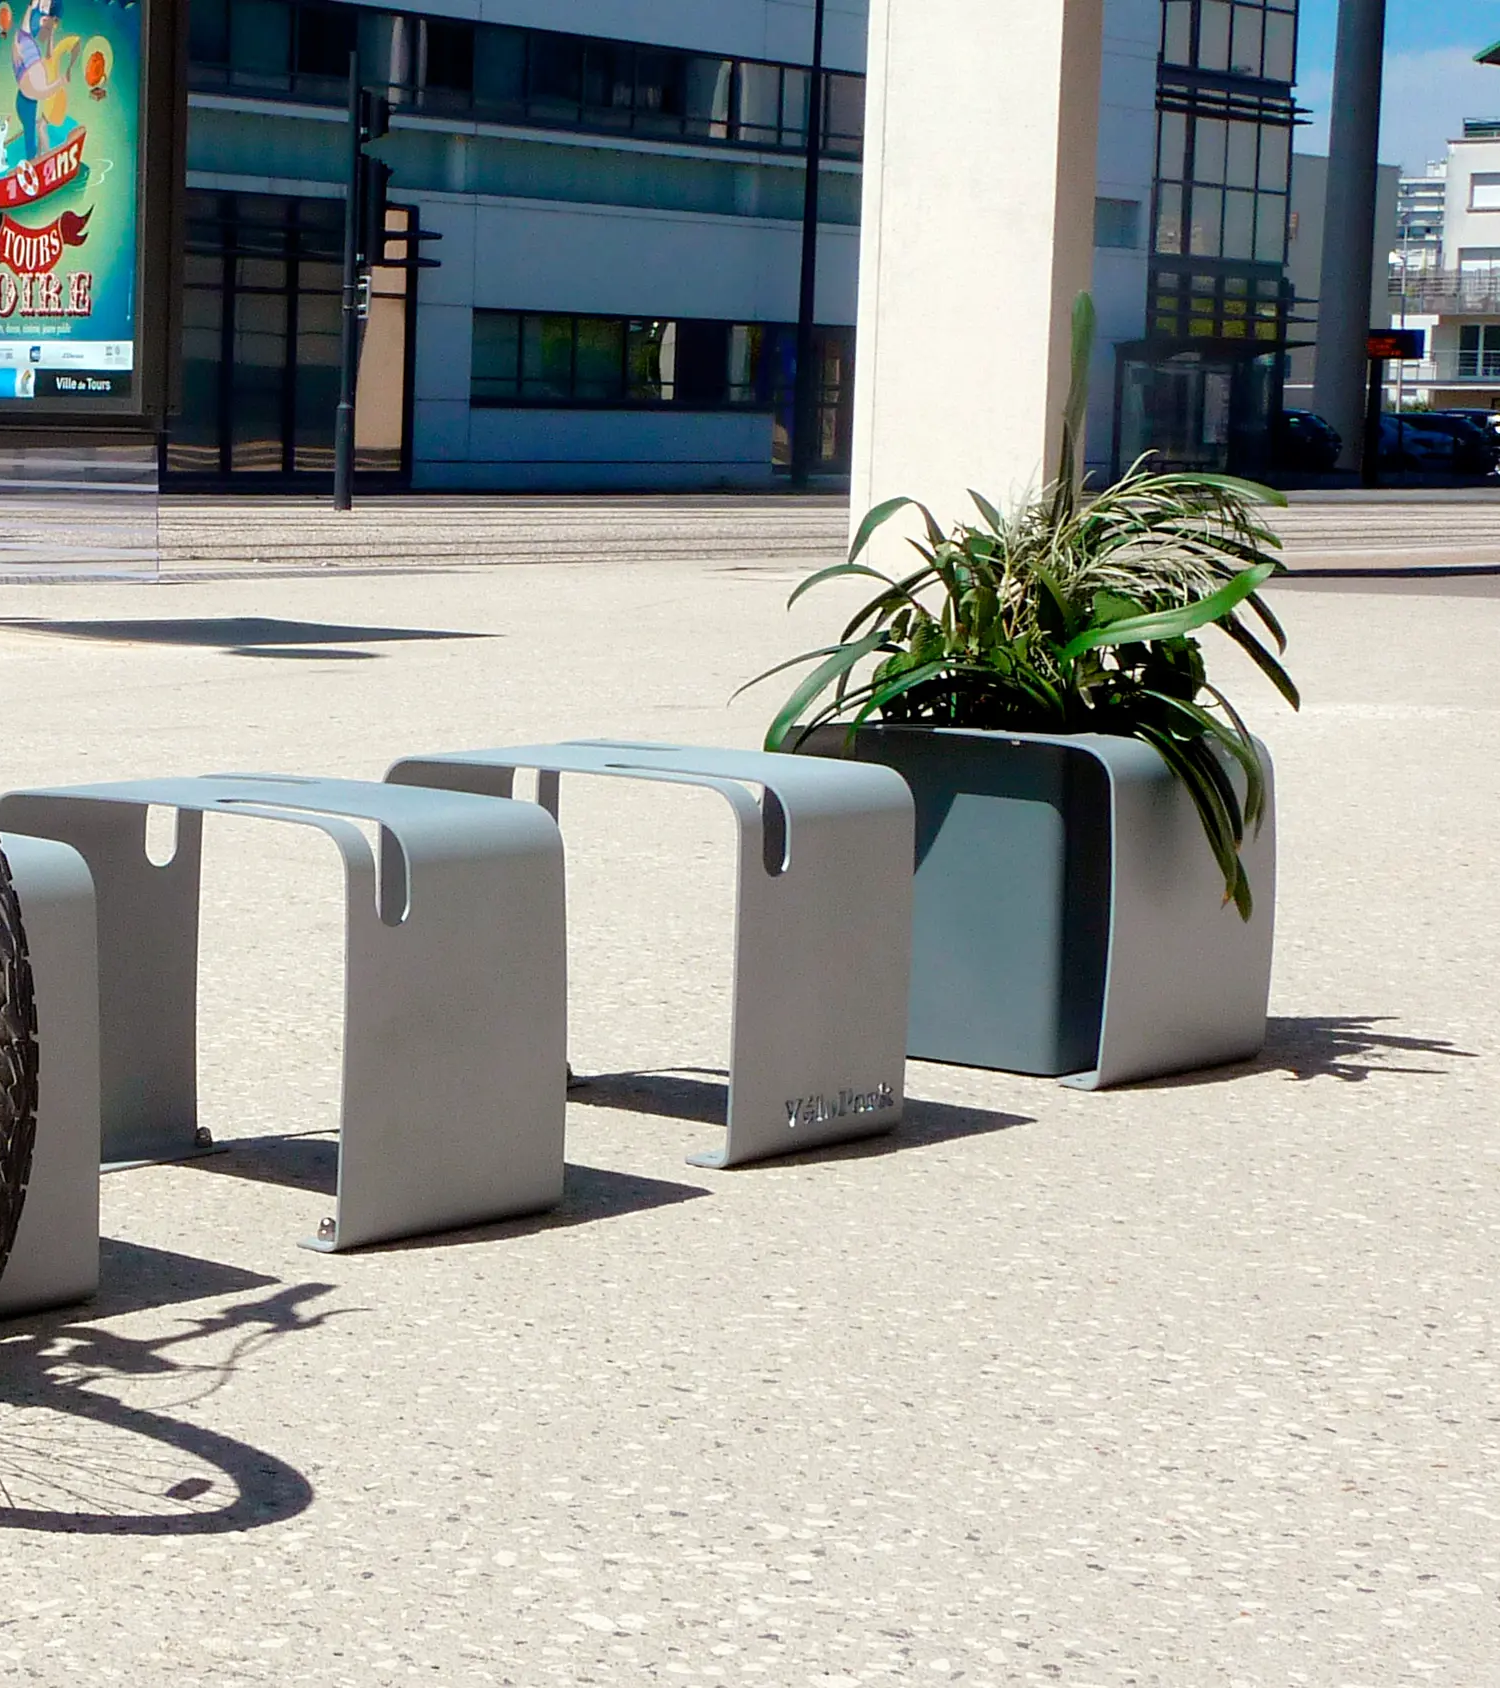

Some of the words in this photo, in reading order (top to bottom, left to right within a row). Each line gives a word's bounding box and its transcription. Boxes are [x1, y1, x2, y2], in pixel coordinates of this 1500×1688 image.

[3, 226, 61, 271] TOURS
[55, 376, 78, 390] Ville
[87, 376, 112, 391] Tours
